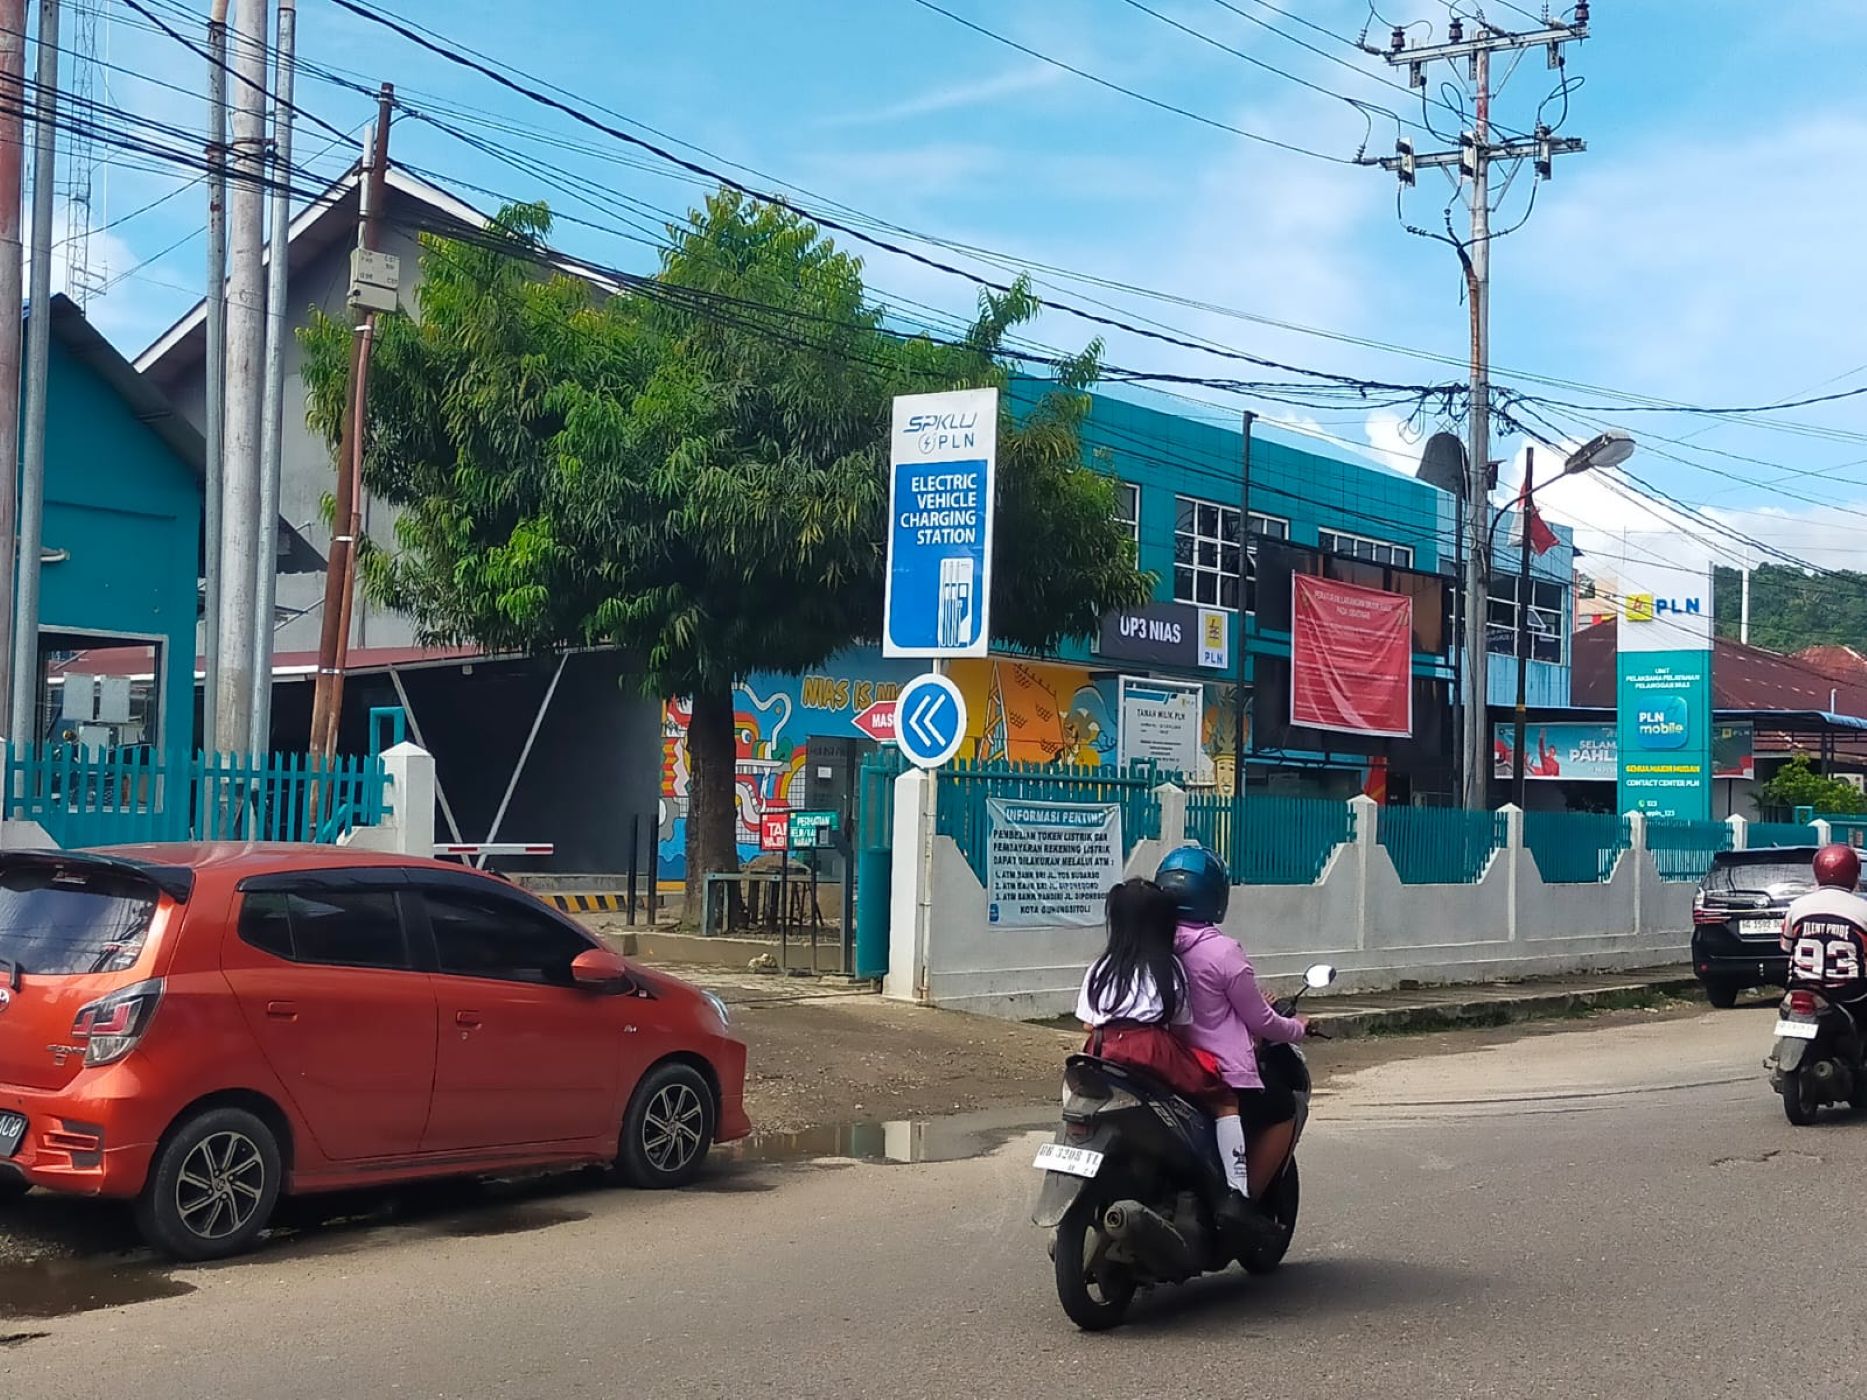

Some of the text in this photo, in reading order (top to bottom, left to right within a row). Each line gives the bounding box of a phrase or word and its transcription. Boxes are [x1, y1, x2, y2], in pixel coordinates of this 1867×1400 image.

[903, 412, 978, 433] SPKLU
[938, 432, 975, 449] PLN
[911, 473, 977, 492] ELECTRIC
[917, 492, 977, 509] VEHICLE
[901, 510, 976, 528] CHARGING
[917, 528, 976, 545] STATION
[1656, 597, 1700, 616] PLN
[1120, 615, 1182, 643] UP3 NIAS
[1204, 651, 1224, 664] PLN
[803, 676, 849, 711] NIAS
[854, 680, 873, 711] IS
[872, 714, 895, 728] MAS
[1639, 711, 1665, 722] PLN
[1640, 722, 1684, 734] mobile
[1579, 740, 1617, 750] SELAM
[1006, 808, 1060, 823] INFORMASI
[1793, 938, 1859, 980] 93
